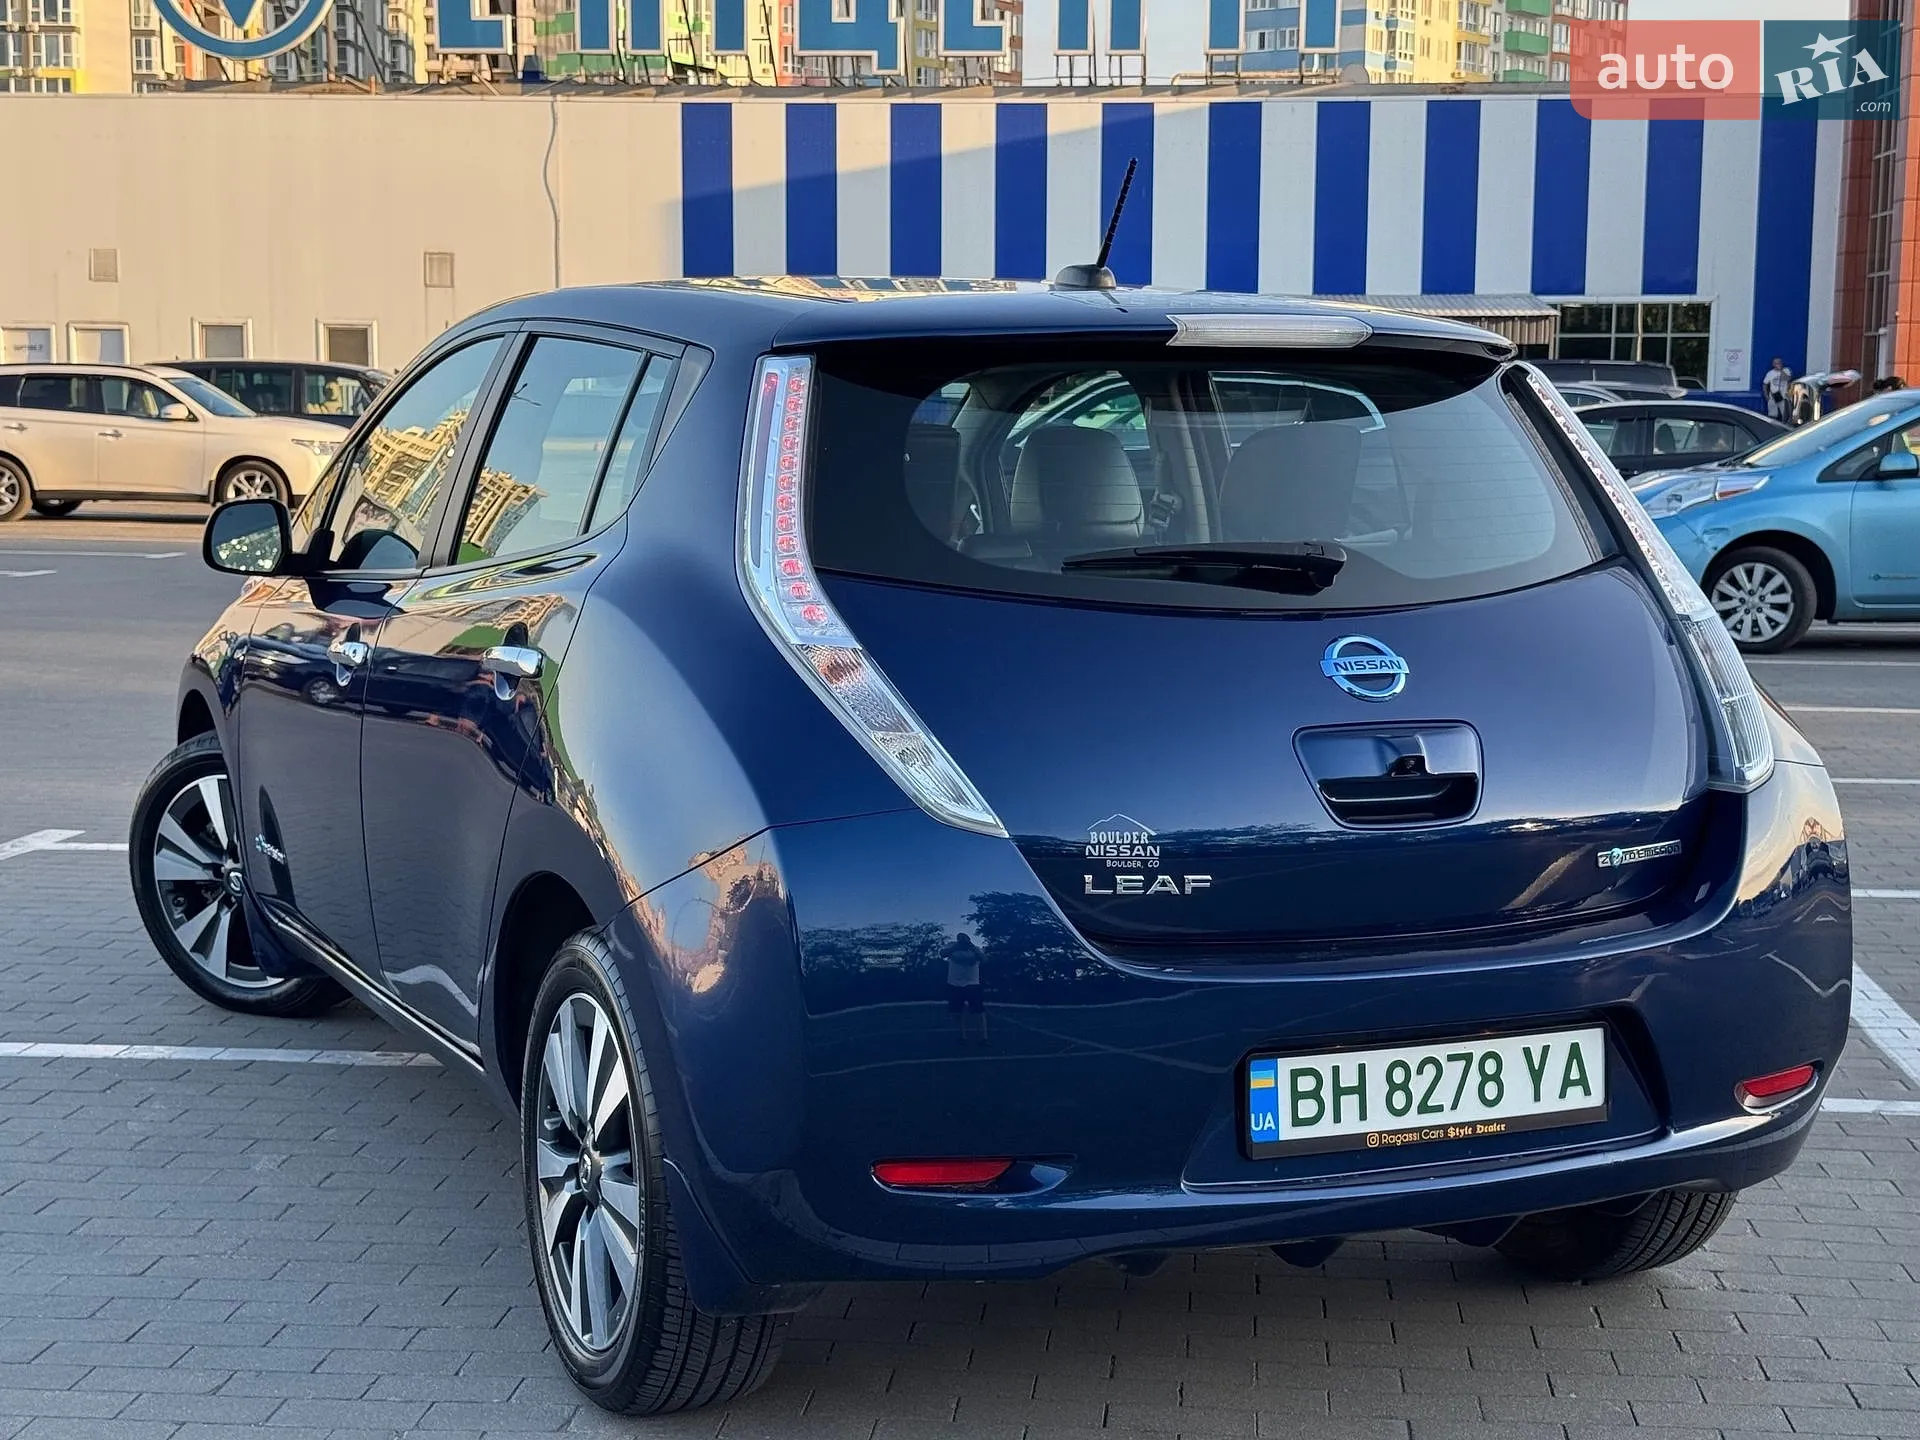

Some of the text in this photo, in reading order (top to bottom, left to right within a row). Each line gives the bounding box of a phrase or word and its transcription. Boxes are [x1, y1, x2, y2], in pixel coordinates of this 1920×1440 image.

[1333, 659, 1402, 672] NISSAN
[1090, 831, 1149, 843] BOULDER
[1085, 845, 1160, 856] NISSAN
[1147, 860, 1160, 868] CO
[1083, 874, 1213, 895] LEAF
[1290, 1041, 1592, 1127] BH 8278 YA
[1251, 1112, 1276, 1132] UA
[1381, 1132, 1420, 1146] Ragassi
[1421, 1128, 1444, 1140] Cars
[1475, 1122, 1506, 1134] Dealer
